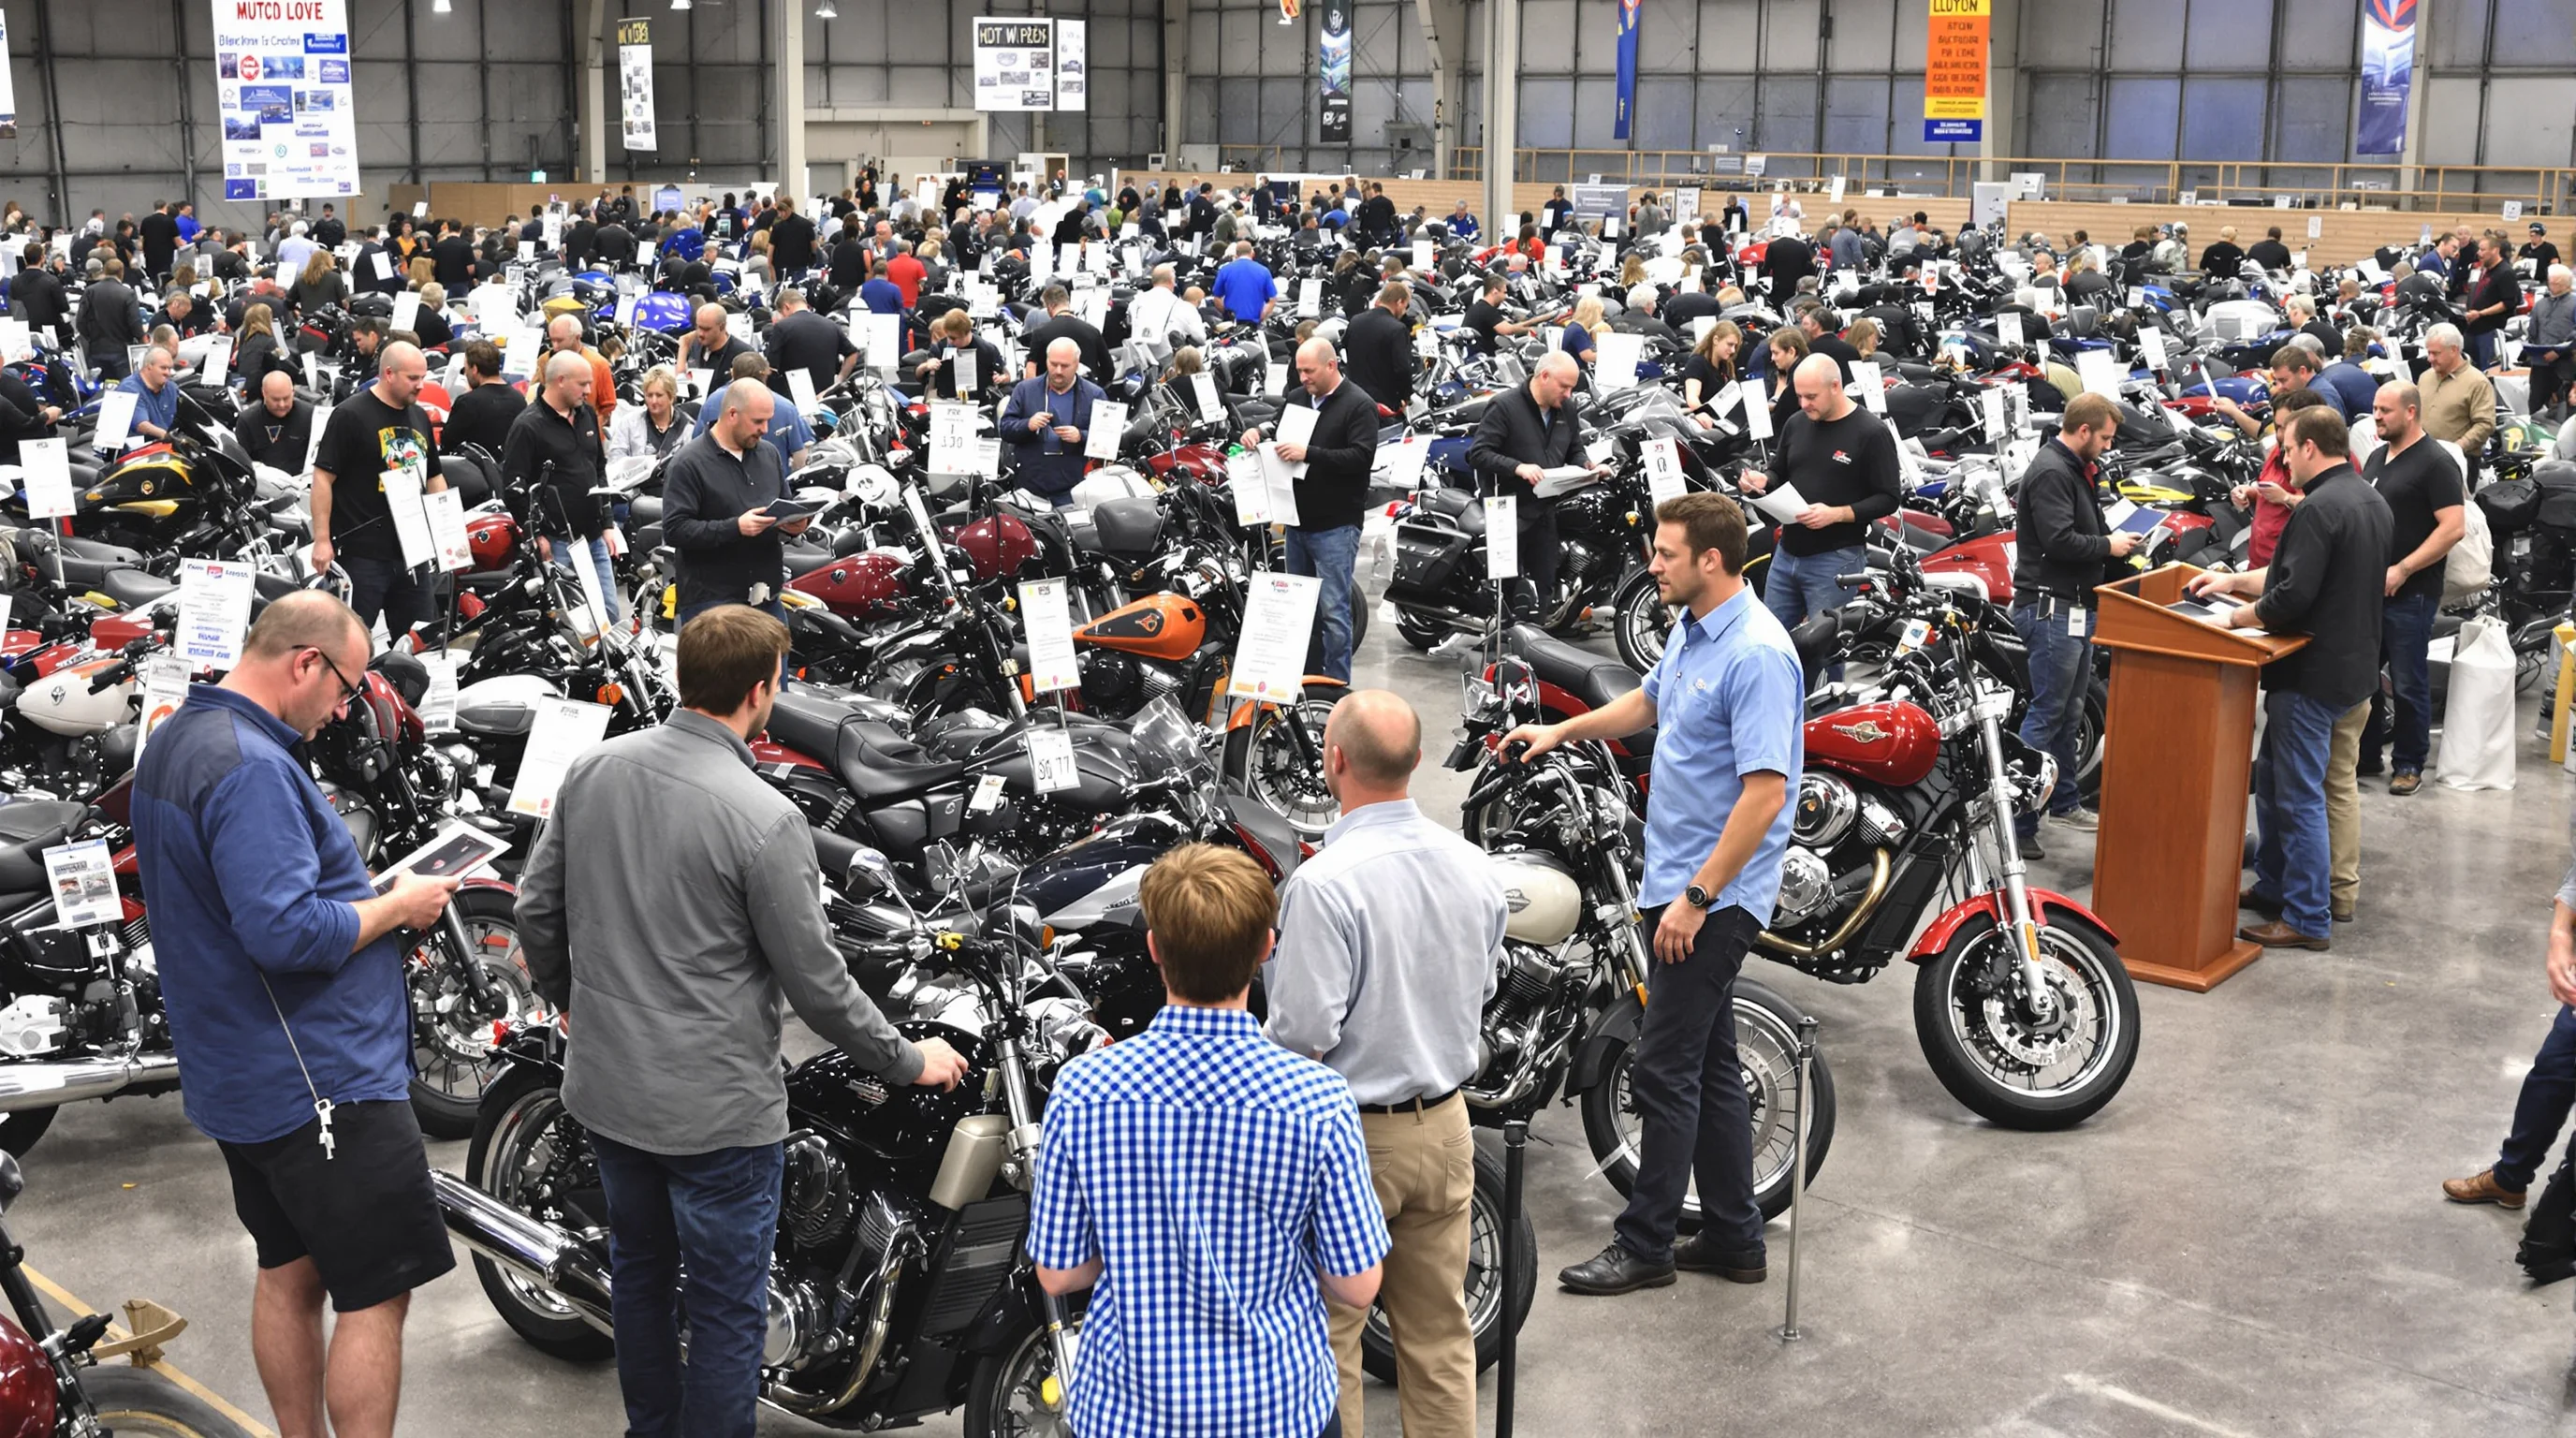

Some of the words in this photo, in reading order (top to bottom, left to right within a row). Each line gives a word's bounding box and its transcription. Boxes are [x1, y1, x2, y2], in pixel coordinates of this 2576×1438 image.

[237, 2, 281, 21] MUTCD
[286, 2, 324, 21] LOVE
[979, 27, 1003, 44] HOT
